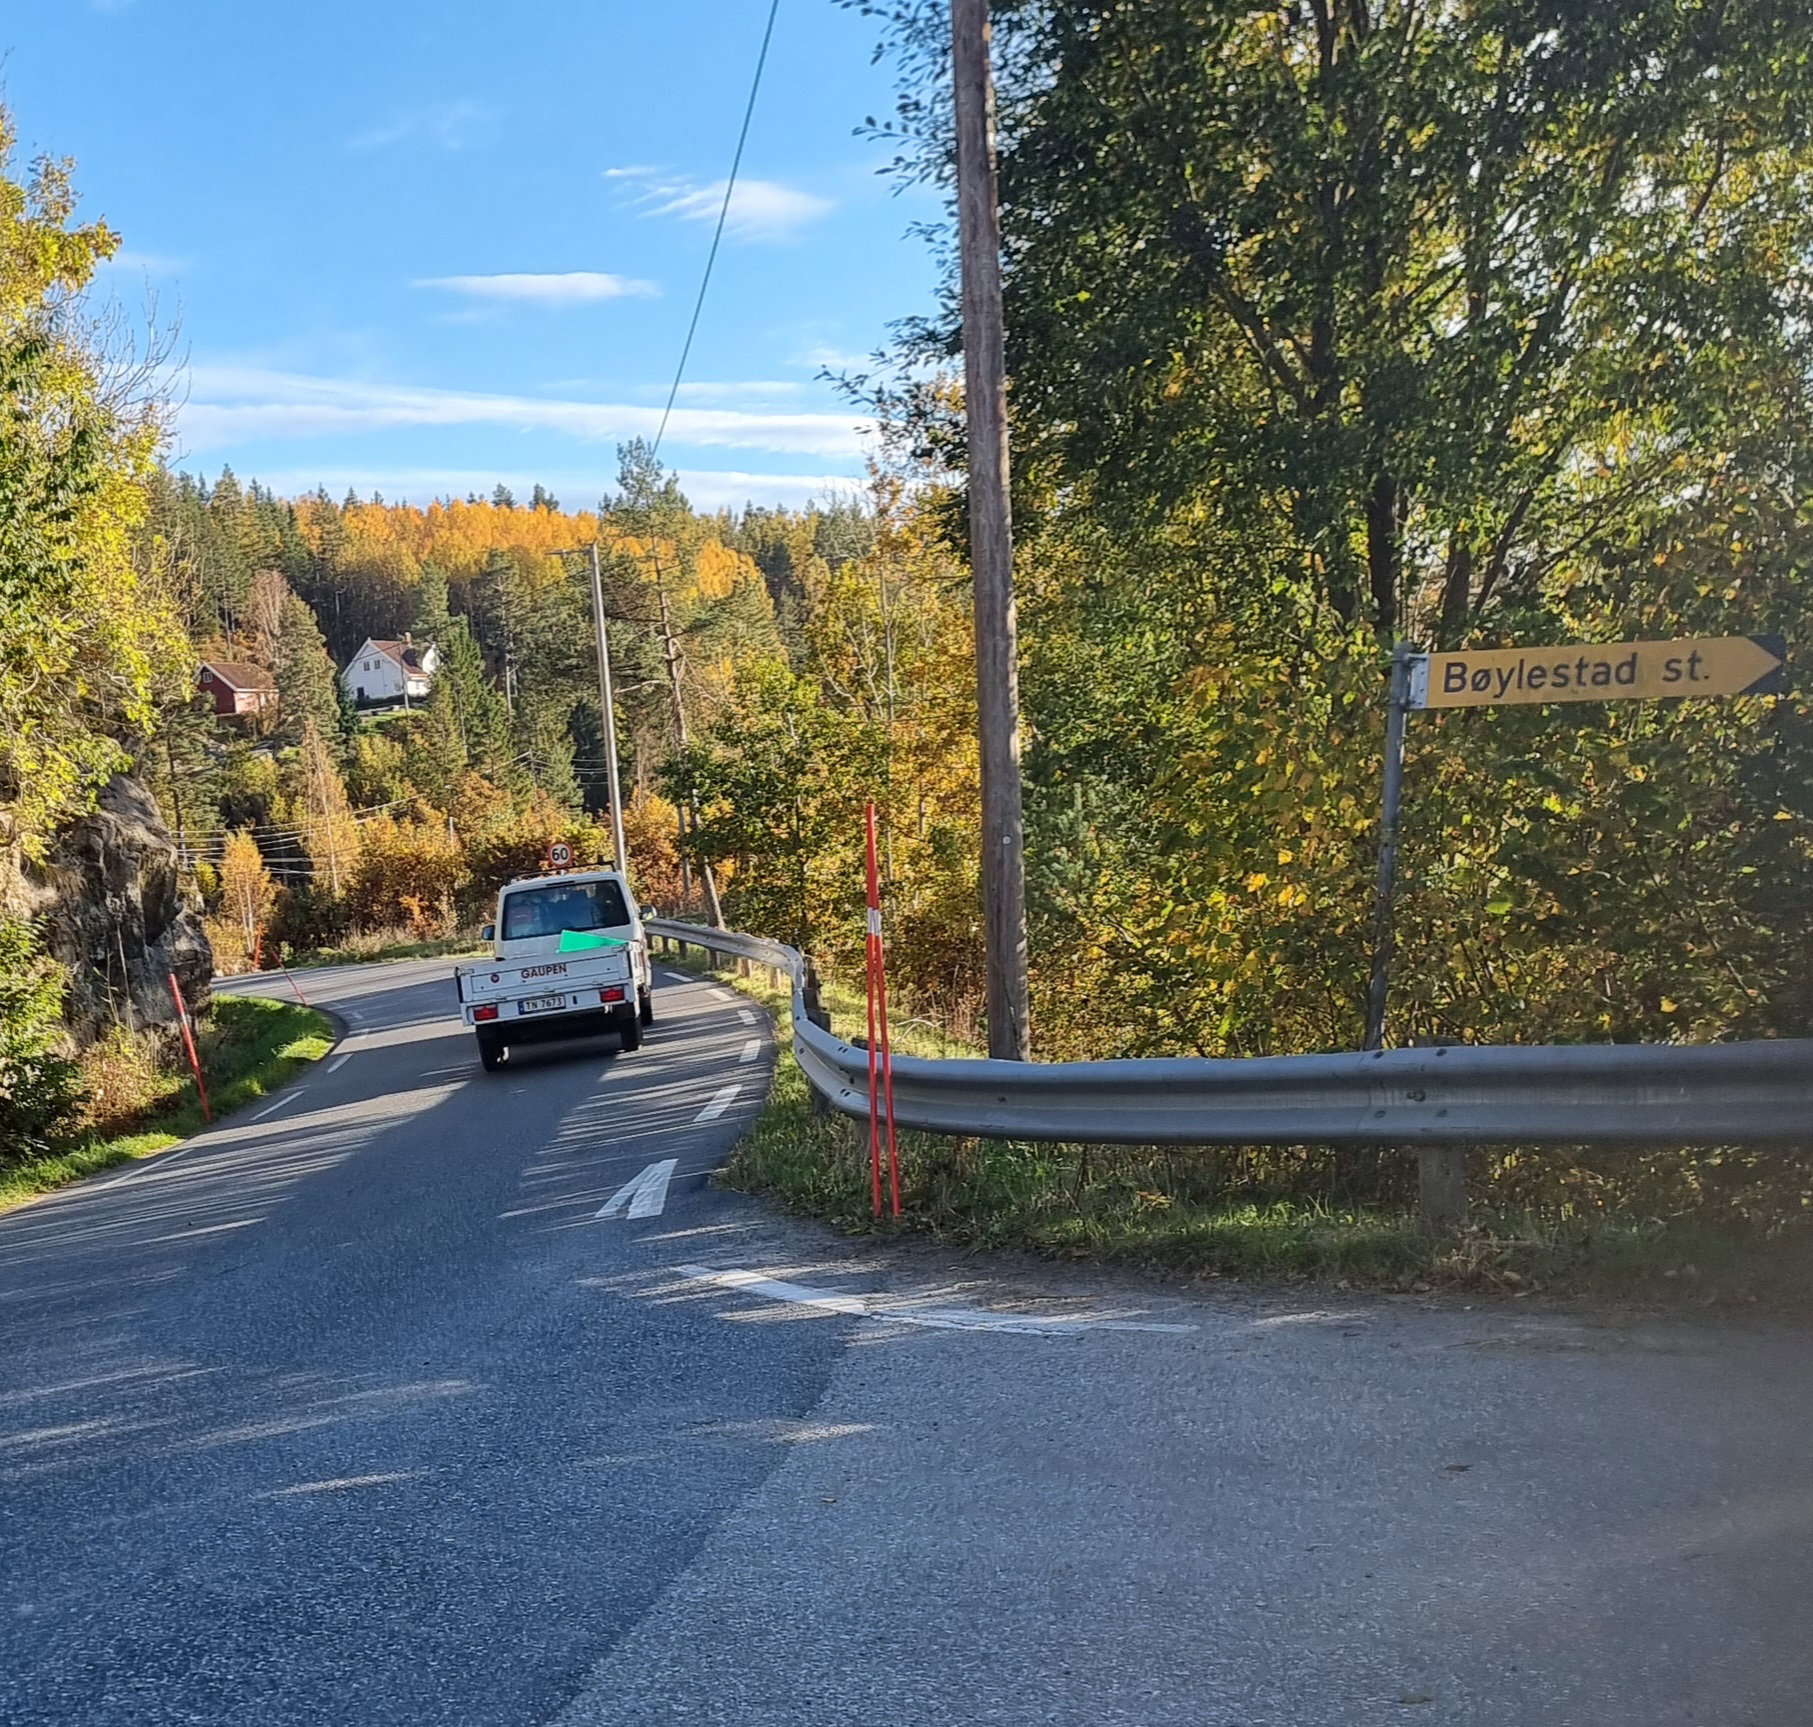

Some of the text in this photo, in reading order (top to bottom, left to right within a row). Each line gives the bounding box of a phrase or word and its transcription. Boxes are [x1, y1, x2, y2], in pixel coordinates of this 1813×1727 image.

[1442, 649, 1711, 698] Bøylestad st.
[551, 847, 569, 861] 60
[521, 963, 567, 979] GAUPEN
[540, 998, 562, 1008] 7673
